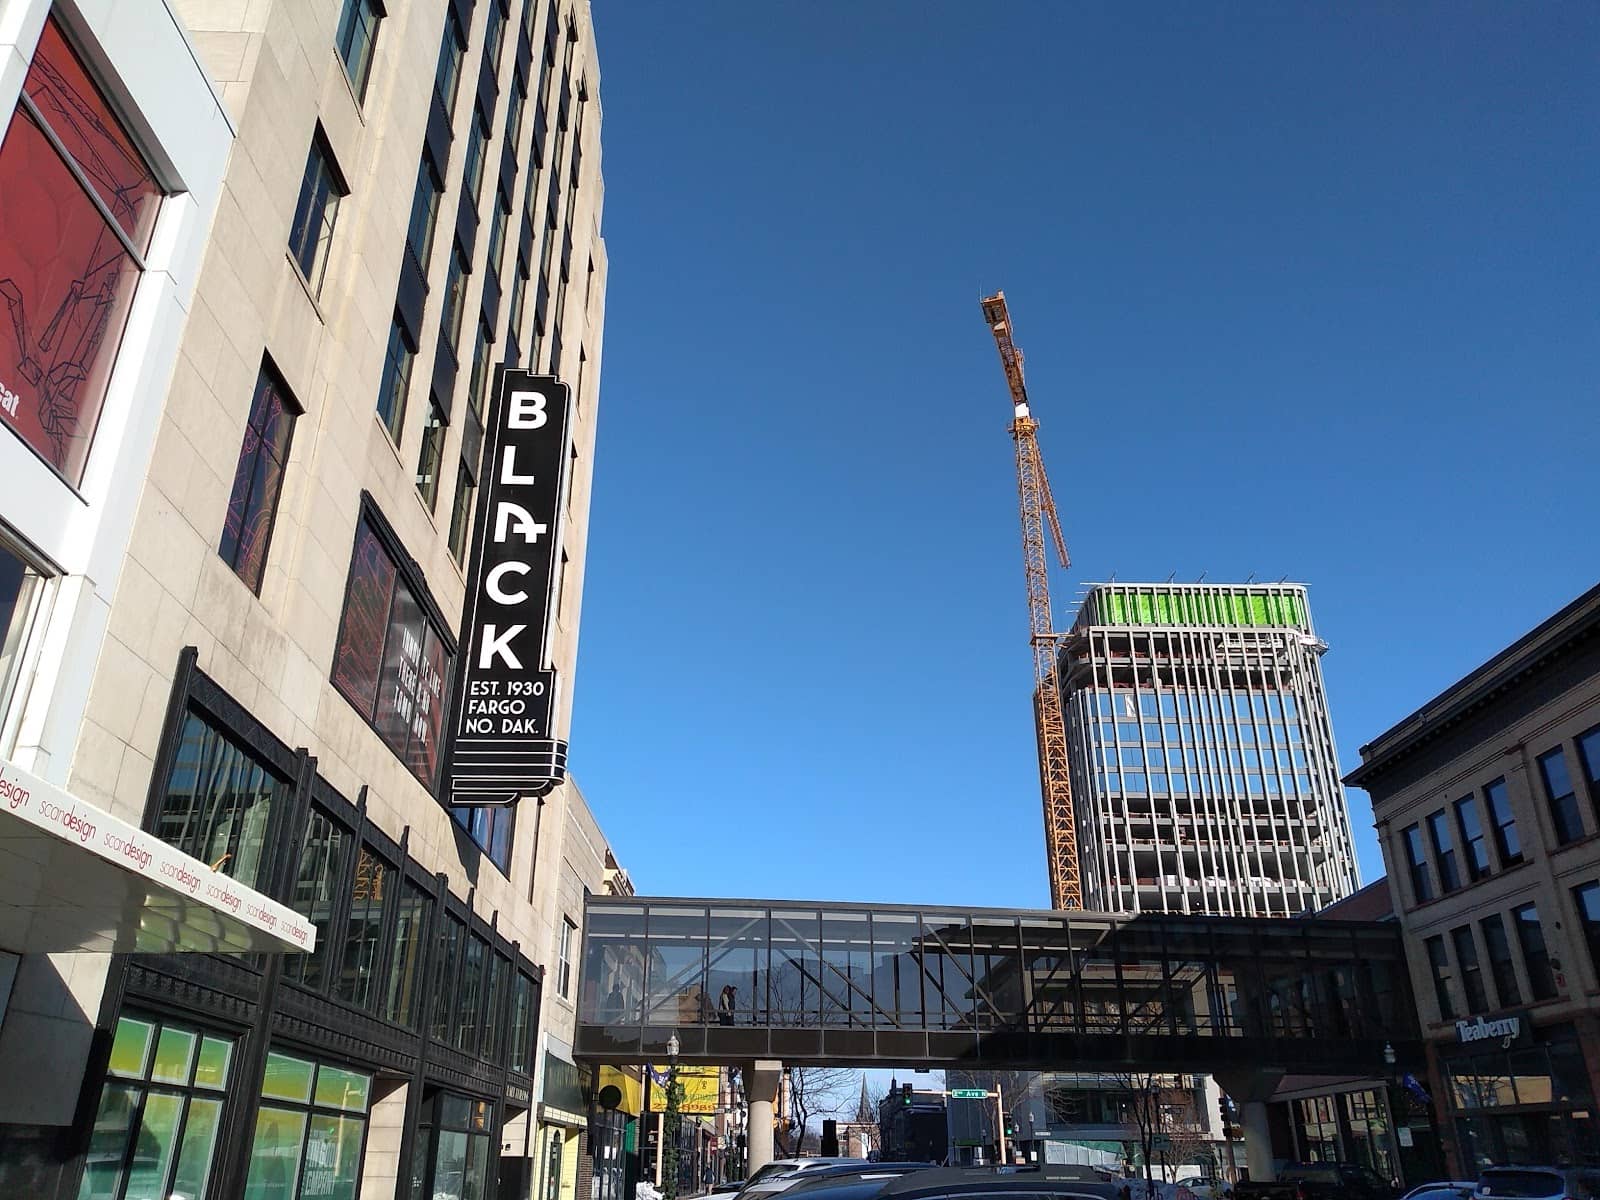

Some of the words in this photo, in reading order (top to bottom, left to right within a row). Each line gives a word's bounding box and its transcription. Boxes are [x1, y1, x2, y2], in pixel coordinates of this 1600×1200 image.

[478, 391, 548, 669] BLACK
[470, 681, 501, 696] EST.
[507, 681, 545, 696] 1930
[393, 685, 429, 747] TOMOROW.
[468, 699, 526, 715] FARGO
[465, 718, 496, 734] NO.
[501, 718, 540, 734] DAK.
[38, 799, 97, 842] scandesign
[103, 831, 153, 867] scandesign
[159, 858, 201, 889] scandesign
[206, 882, 243, 911] scandesign
[246, 902, 278, 930] scandesign
[1455, 1016, 1520, 1042] Teaberry
